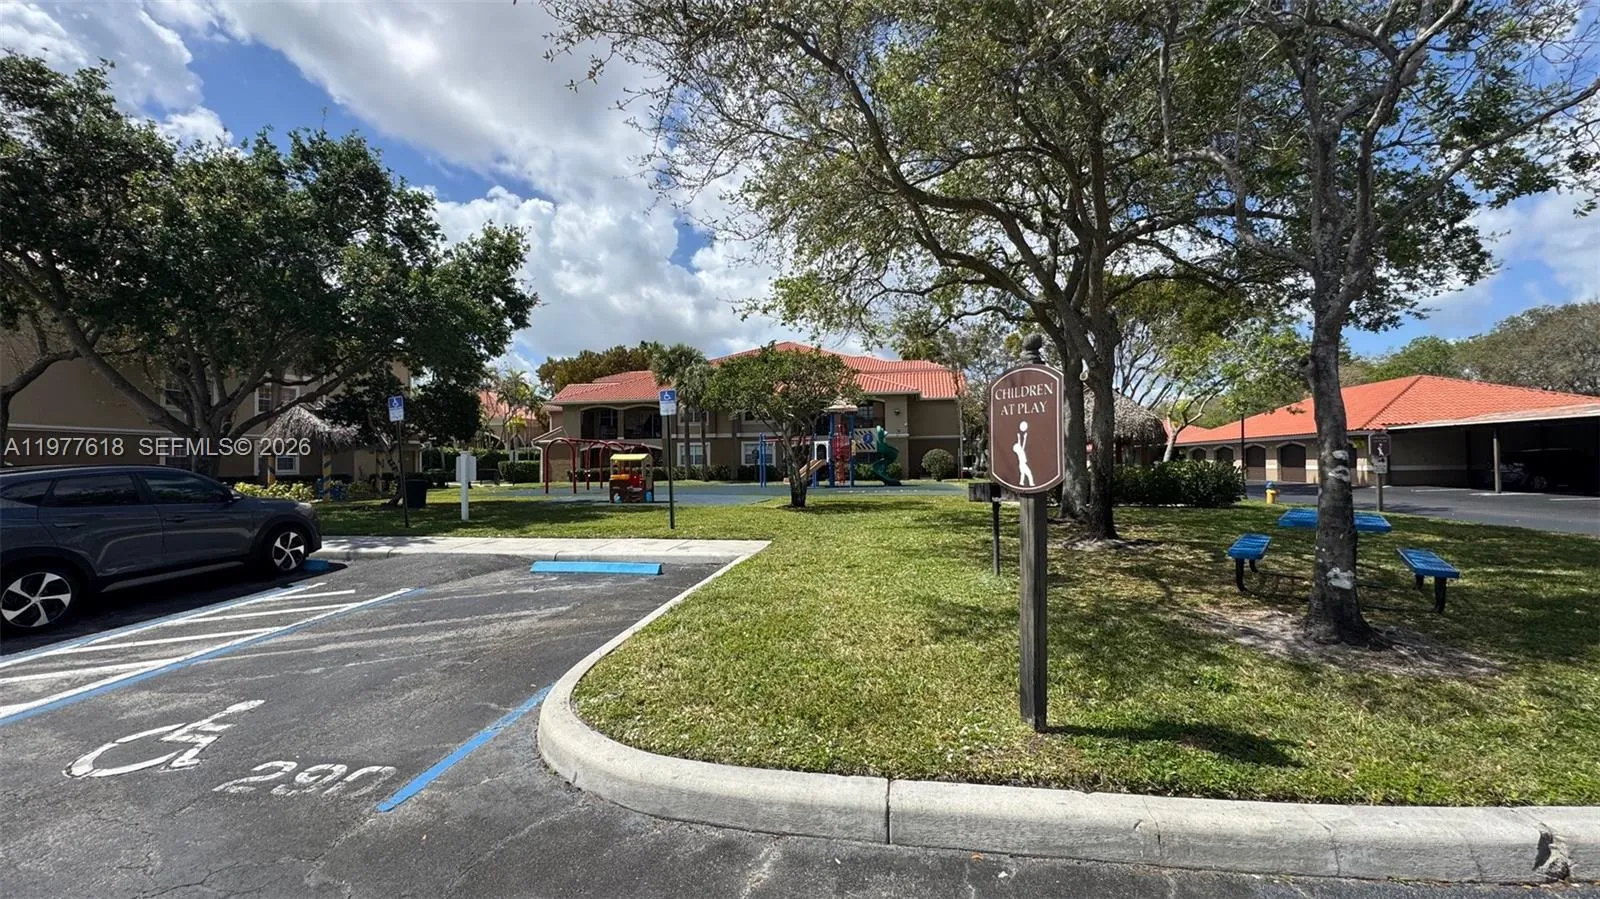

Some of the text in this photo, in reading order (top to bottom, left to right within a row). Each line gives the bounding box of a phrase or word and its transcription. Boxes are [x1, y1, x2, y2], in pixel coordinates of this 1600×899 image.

[995, 382, 1053, 400] CHILDREN
[1001, 401, 1048, 416] AT PLAY
